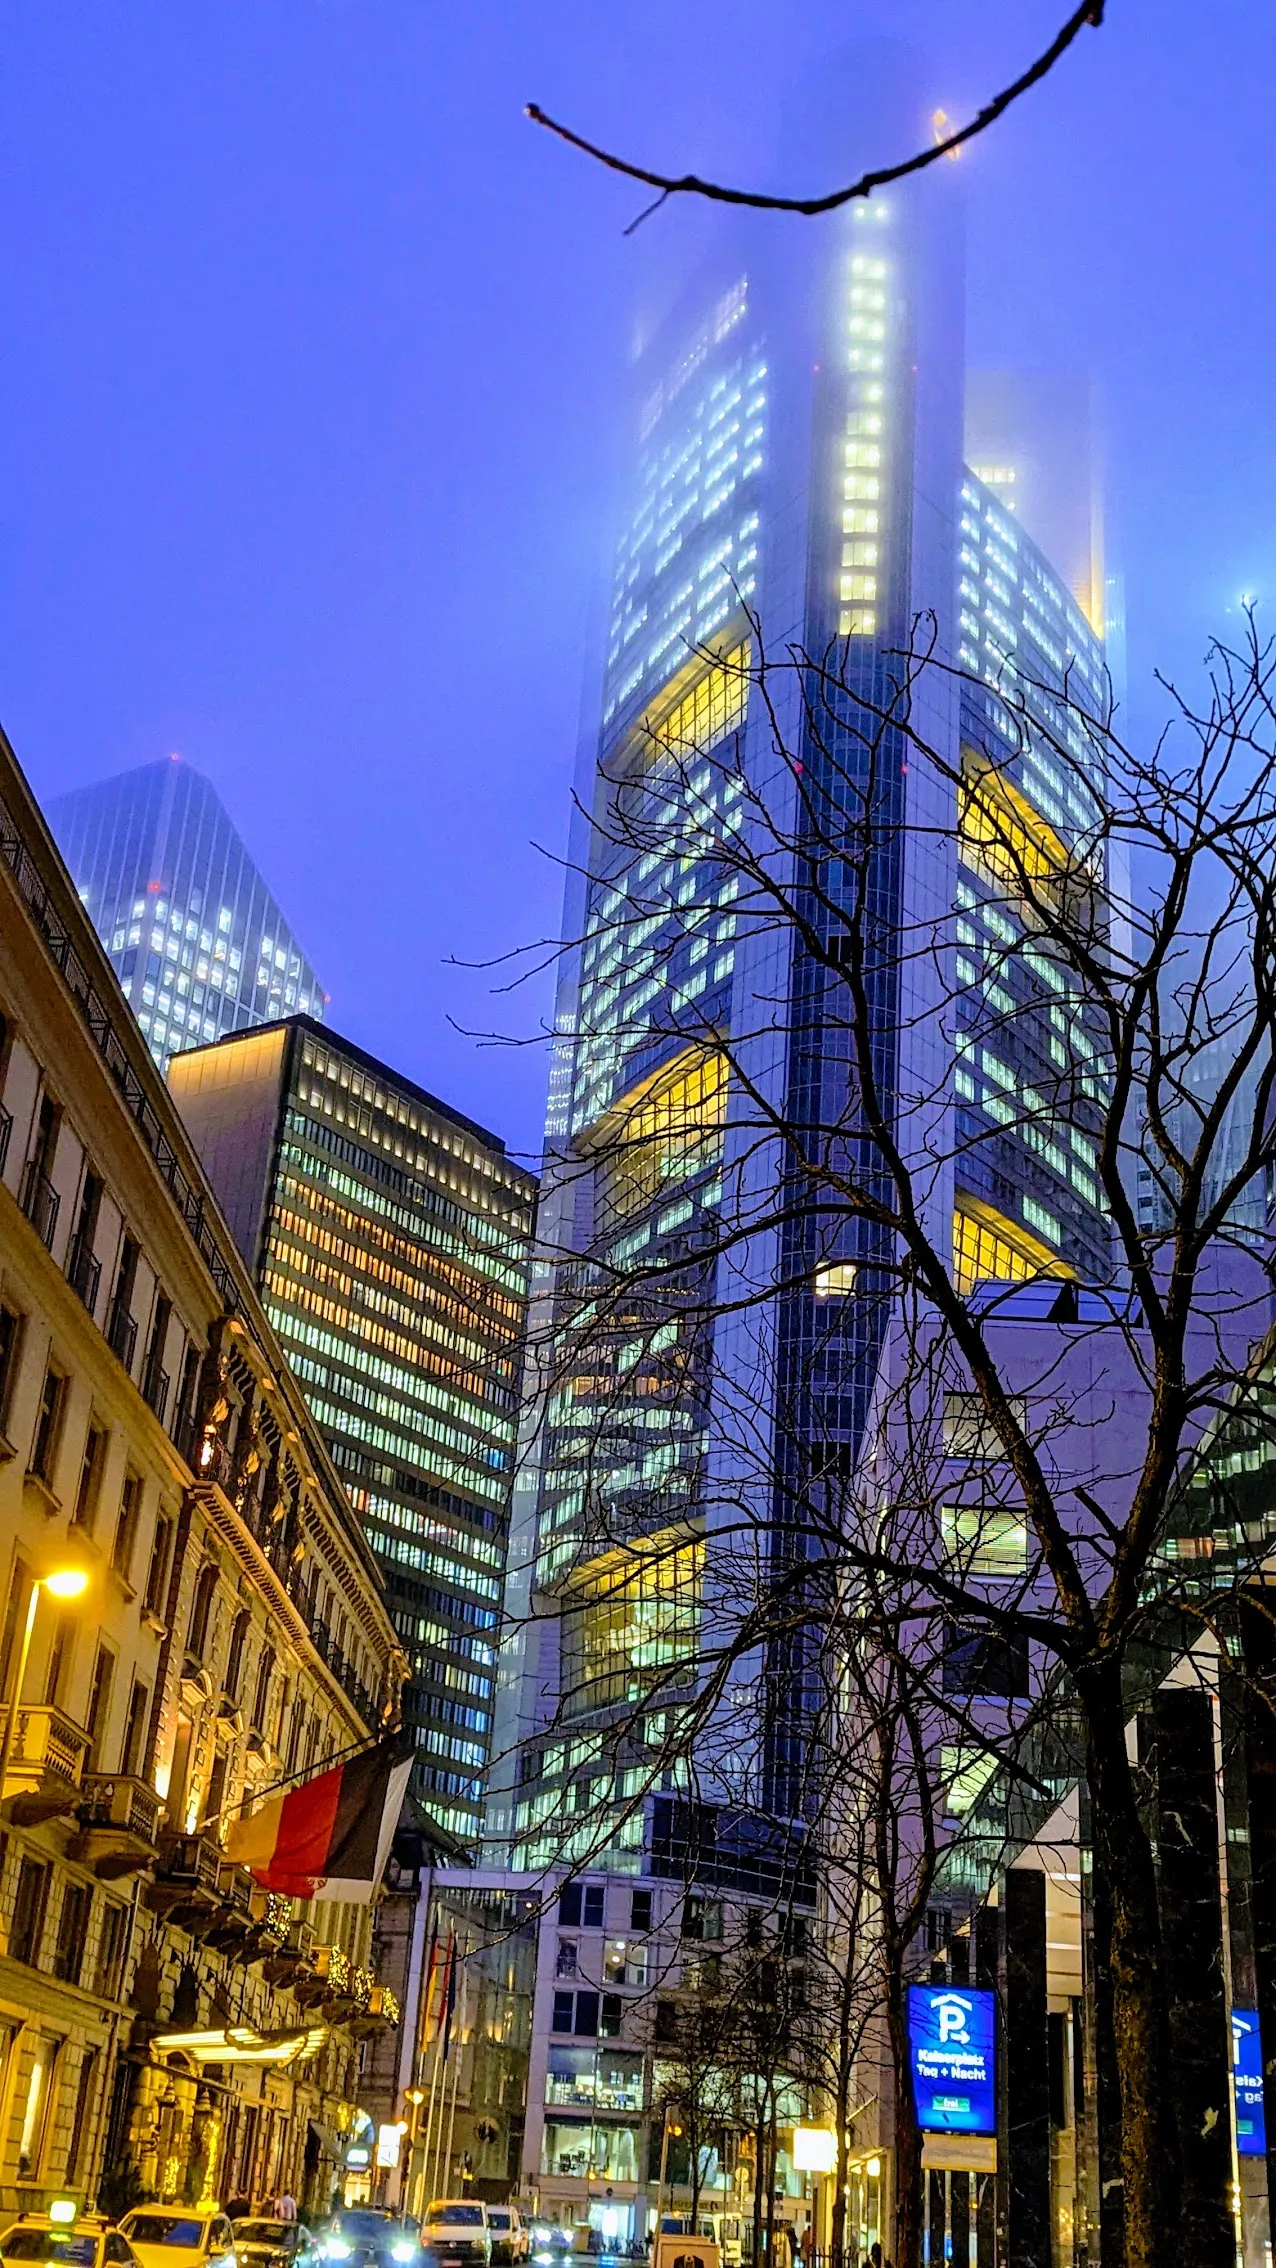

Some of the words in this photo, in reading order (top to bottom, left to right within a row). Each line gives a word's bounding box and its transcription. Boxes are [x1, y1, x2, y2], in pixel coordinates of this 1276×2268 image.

[939, 2004, 966, 2043] P
[918, 2048, 985, 2067] Kaiserplatz
[916, 2063, 938, 2079] Tag
[950, 2065, 987, 2081] Nacht
[943, 2097, 959, 2109] frei
